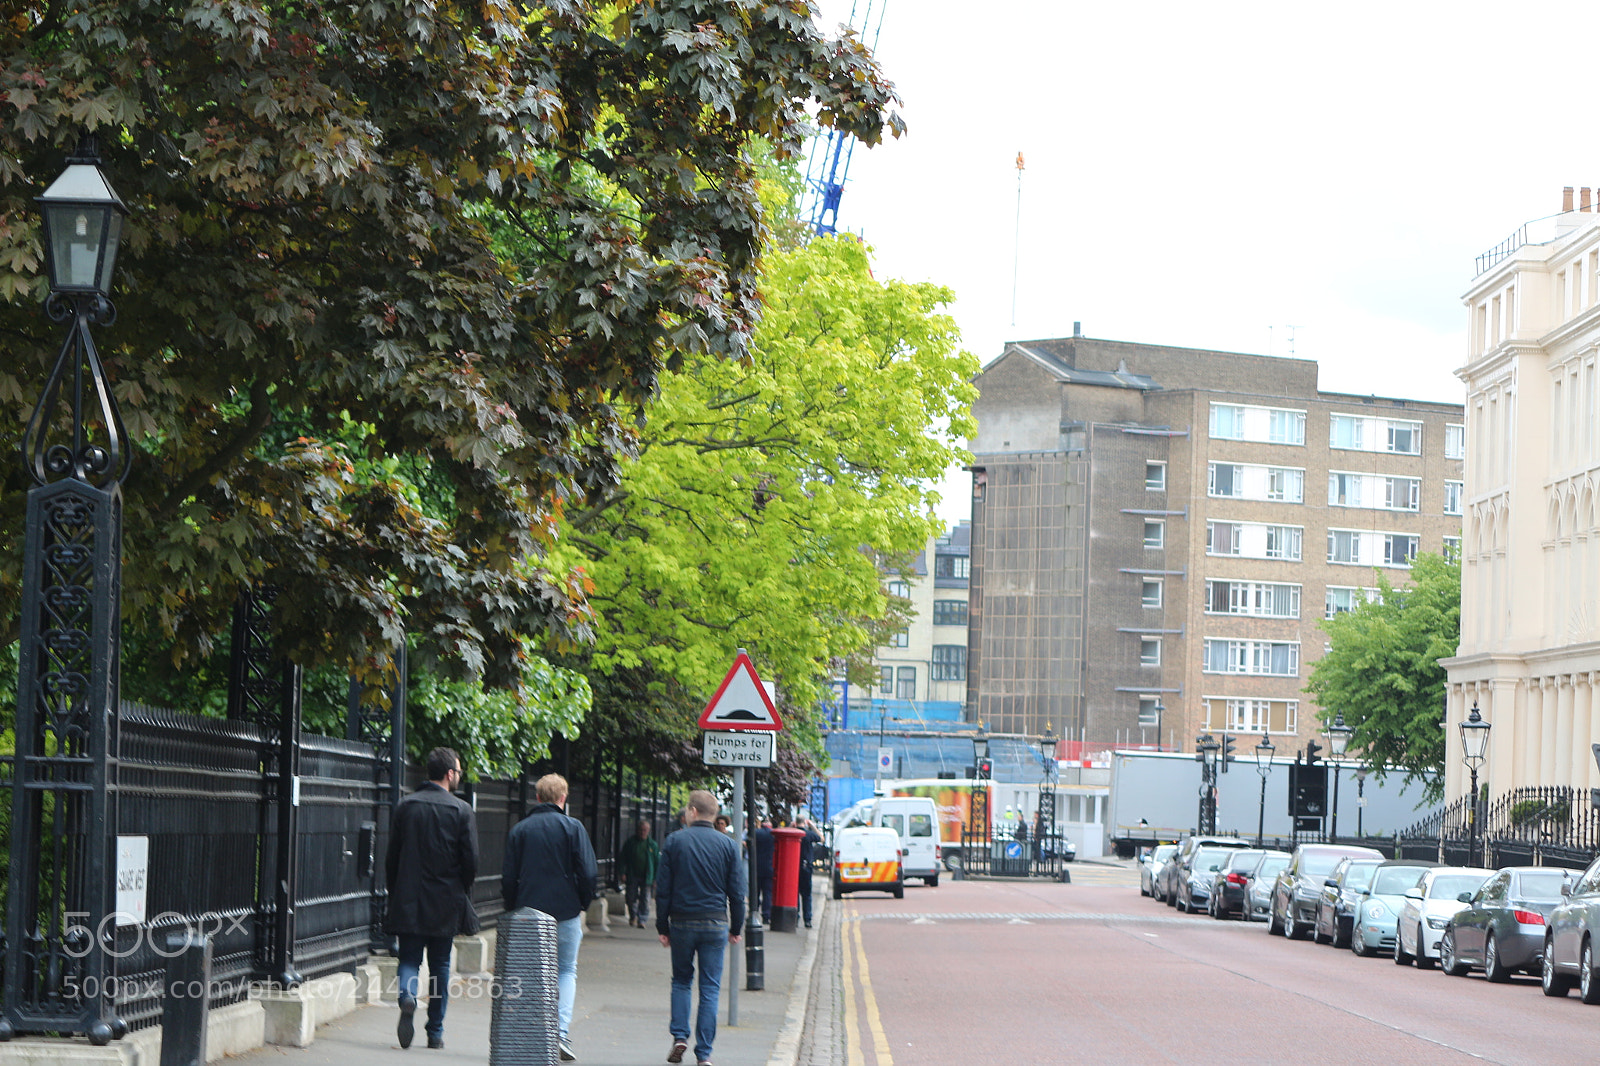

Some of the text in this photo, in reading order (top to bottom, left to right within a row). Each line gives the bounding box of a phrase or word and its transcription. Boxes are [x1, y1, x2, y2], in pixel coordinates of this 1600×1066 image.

[708, 735, 767, 749] Humps for
[712, 749, 762, 763] 50 yards
